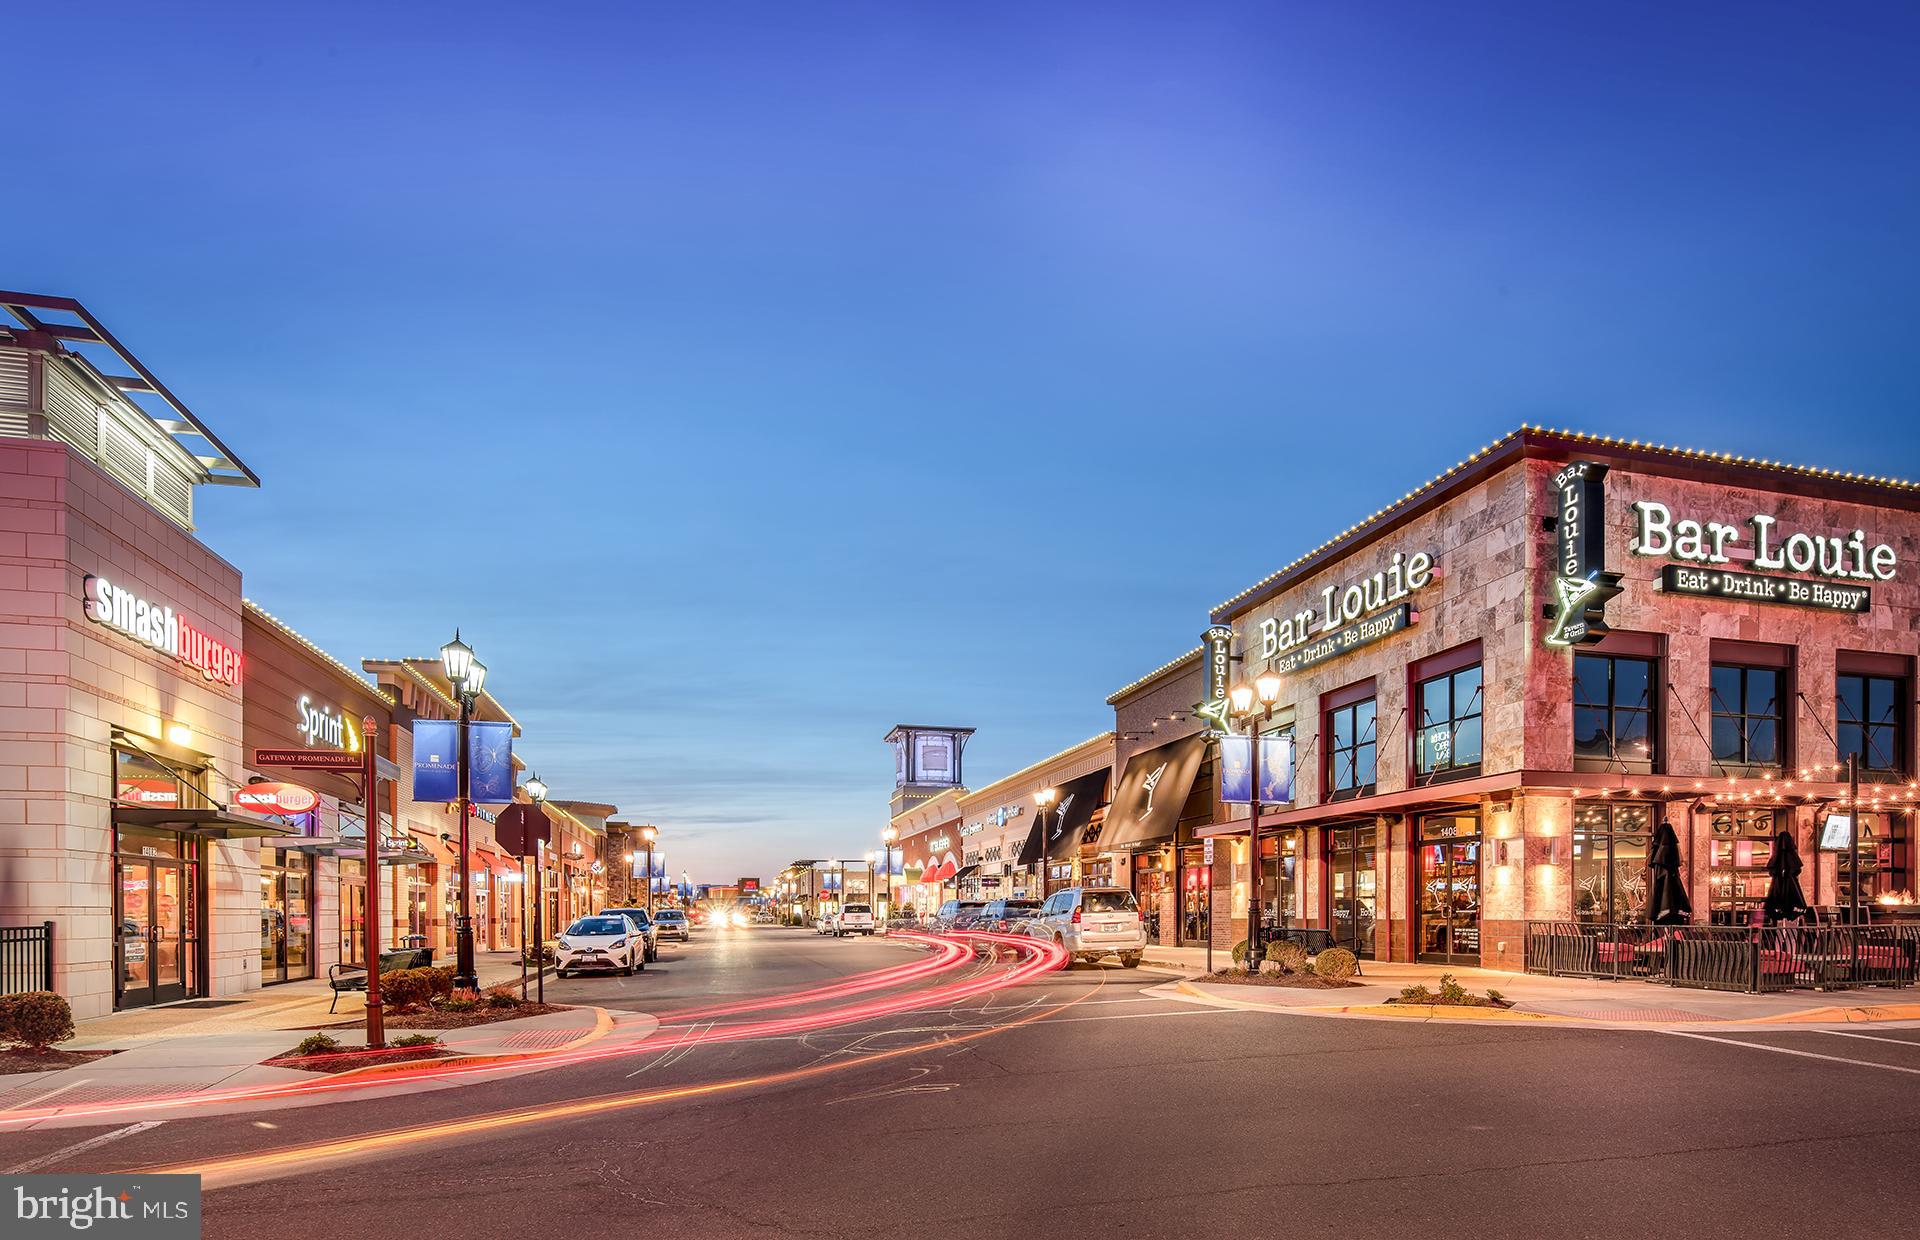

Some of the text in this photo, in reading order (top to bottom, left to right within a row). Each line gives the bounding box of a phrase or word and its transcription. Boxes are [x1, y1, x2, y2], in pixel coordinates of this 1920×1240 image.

[1555, 464, 1587, 489] Bar
[1563, 484, 1579, 576] Louie
[1634, 500, 1897, 581] Bar Louie
[1260, 552, 1432, 660] Bar Louie
[1677, 570, 1708, 590] Eat
[1722, 574, 1775, 598] Drink
[1788, 582, 1809, 600] Be
[96, 577, 242, 686] smashburger
[1208, 628, 1233, 640] Bar
[1279, 655, 1296, 674] Eat
[1303, 639, 1335, 664] Drink
[1343, 631, 1358, 647] Be
[1214, 640, 1226, 699] Louie
[299, 695, 344, 748] Sprint
[388, 839, 408, 848] Sprint
[1332, 908, 1349, 918] Happy
